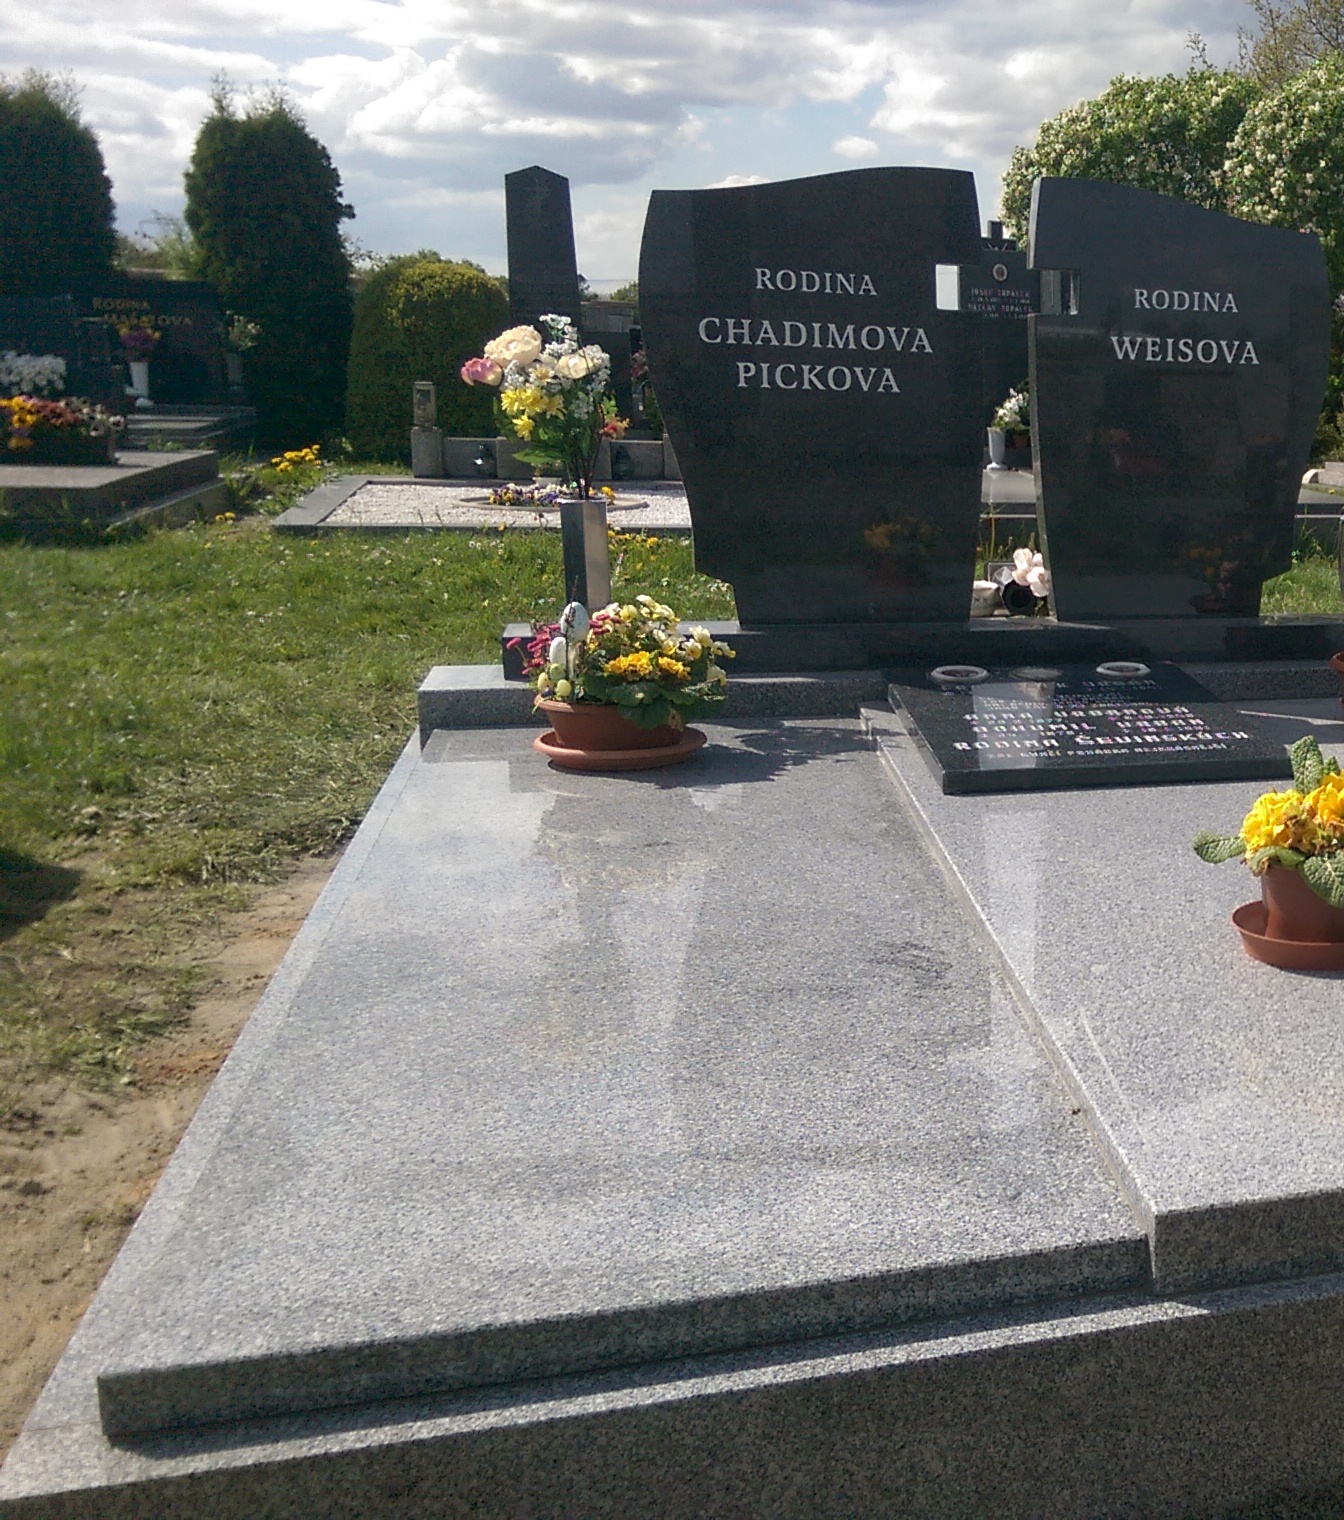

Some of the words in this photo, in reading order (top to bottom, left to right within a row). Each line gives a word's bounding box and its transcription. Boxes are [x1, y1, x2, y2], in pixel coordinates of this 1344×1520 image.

[755, 267, 878, 296] RODINA
[1134, 288, 1239, 313] RODINA
[698, 316, 934, 353] CHADIMOVA
[1110, 336, 1260, 365] WEISOVA
[736, 361, 901, 393] PICKOVA
[952, 738, 1060, 750] RODINA
